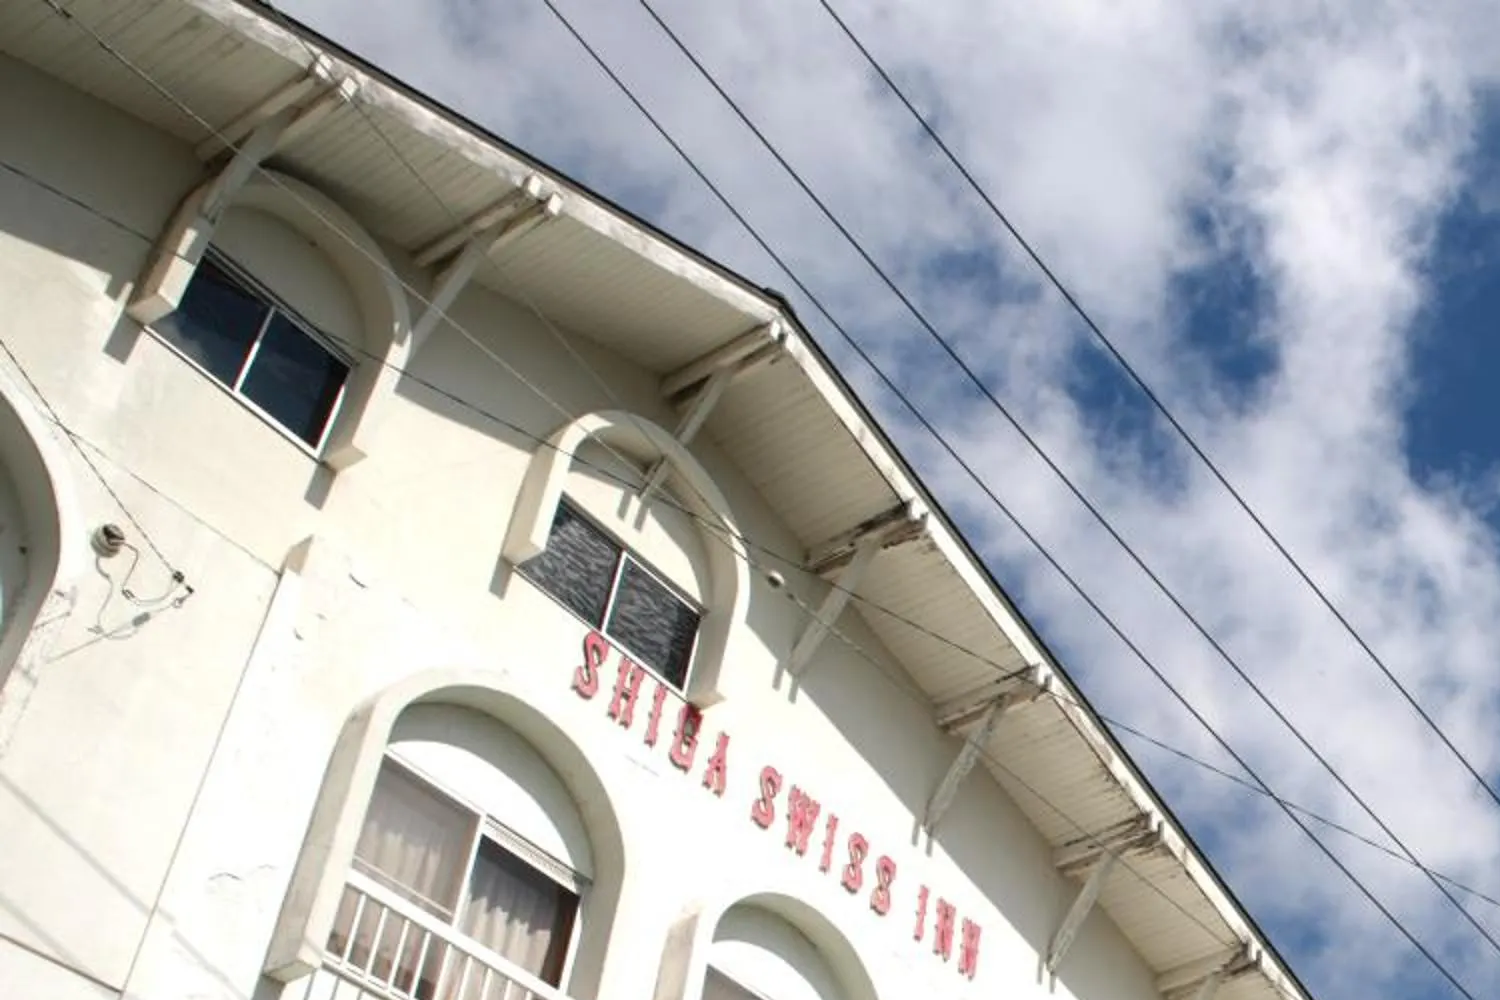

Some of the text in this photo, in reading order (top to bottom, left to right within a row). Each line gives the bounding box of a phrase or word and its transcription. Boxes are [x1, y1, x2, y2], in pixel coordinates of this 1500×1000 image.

[571, 629, 982, 981] SHIGA SWISS INN
